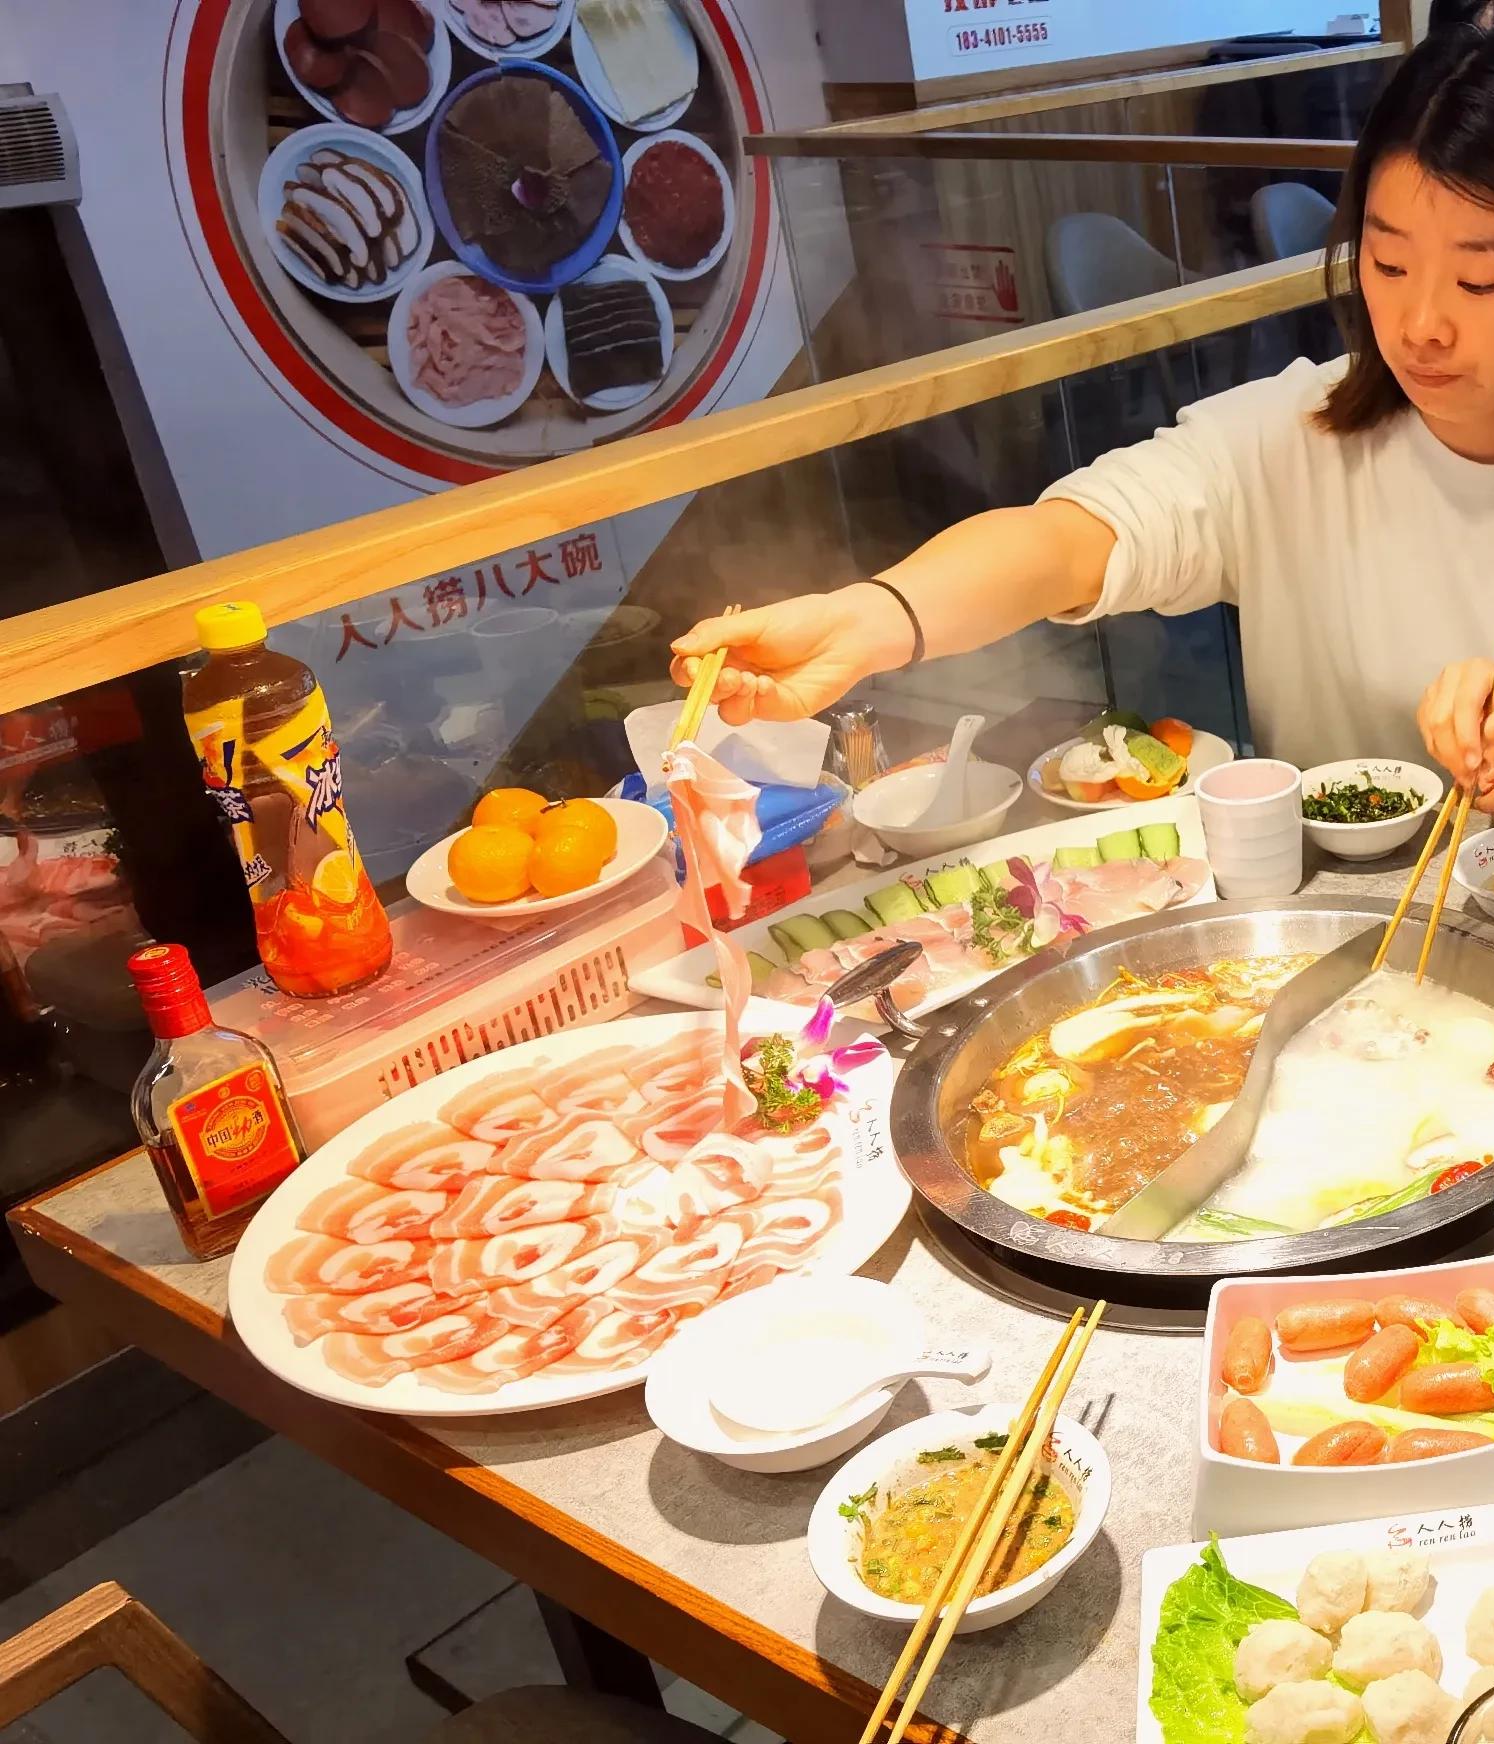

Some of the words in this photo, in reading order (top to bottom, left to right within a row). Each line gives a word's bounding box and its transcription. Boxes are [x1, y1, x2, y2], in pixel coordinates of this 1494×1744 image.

[955, 22, 1048, 51] 183-4101-5555
[334, 532, 603, 664] 人人捞八大碗
[1417, 1513, 1473, 1535] 人人捞
[1419, 1537, 1436, 1547] ren
[1439, 1534, 1456, 1544] ren
[1459, 1529, 1477, 1540] lao
